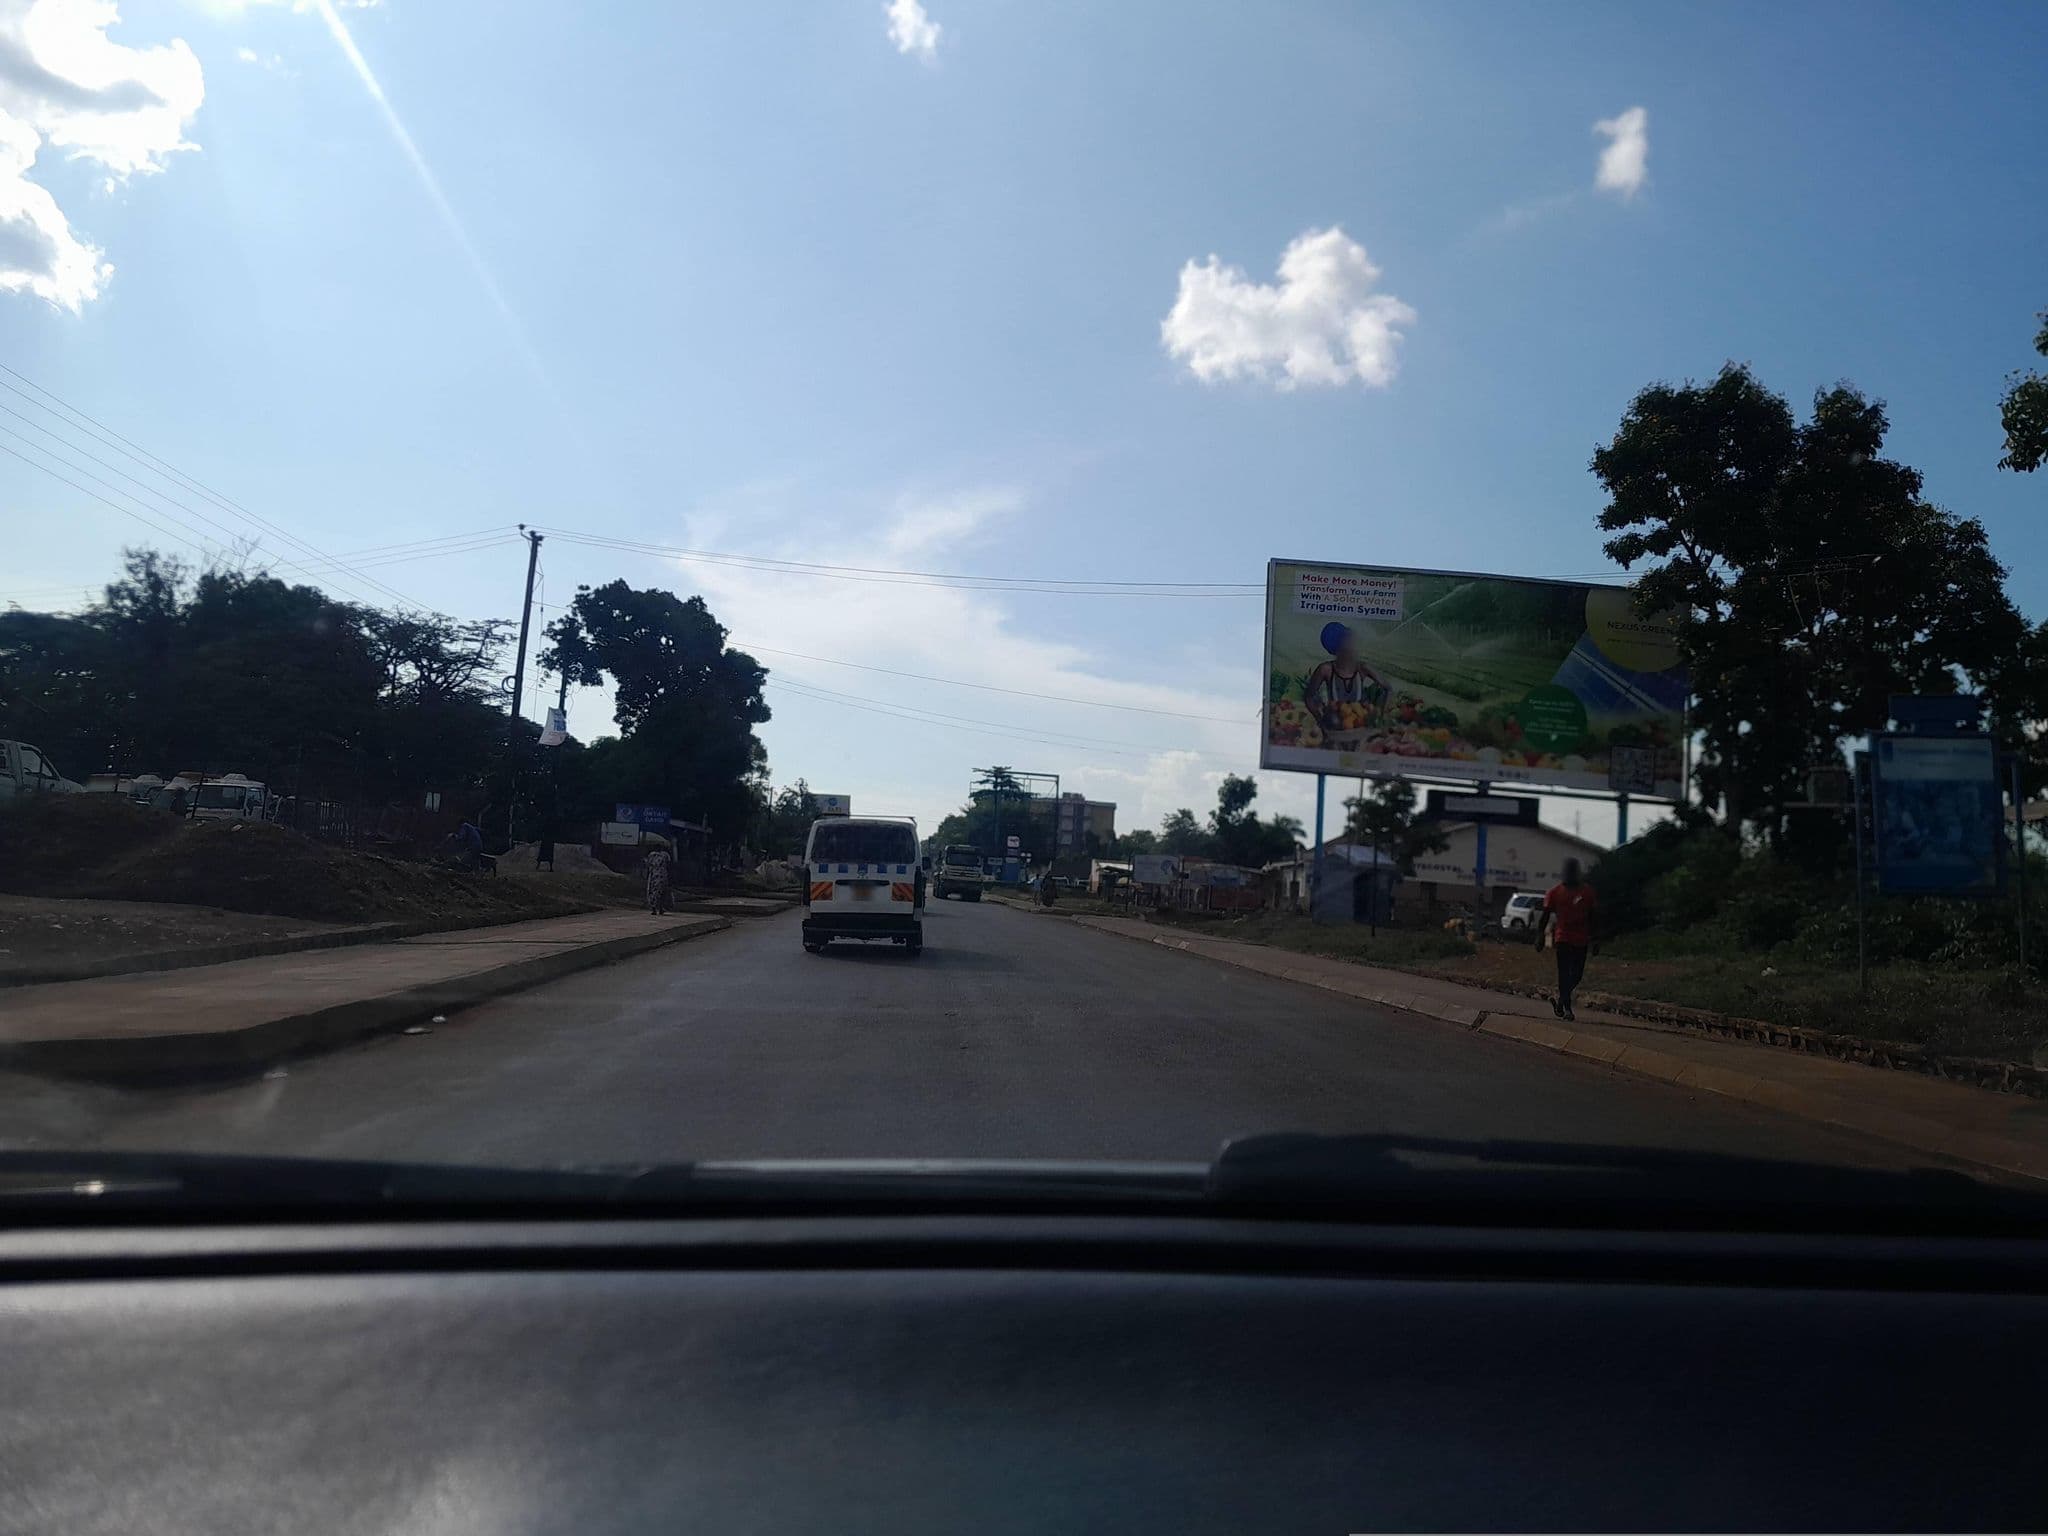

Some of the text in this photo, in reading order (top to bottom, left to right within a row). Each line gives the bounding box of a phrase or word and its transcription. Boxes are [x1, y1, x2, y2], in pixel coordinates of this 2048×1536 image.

[1302, 574, 1397, 590] Make More Money!
[1302, 584, 1397, 597] Transform Your Farm
[1300, 592, 1321, 600] With
[1333, 594, 1360, 603] Solar
[1363, 596, 1396, 606] Water
[1300, 601, 1396, 616] Irrigation System
[1607, 621, 1638, 632] NEXUS
